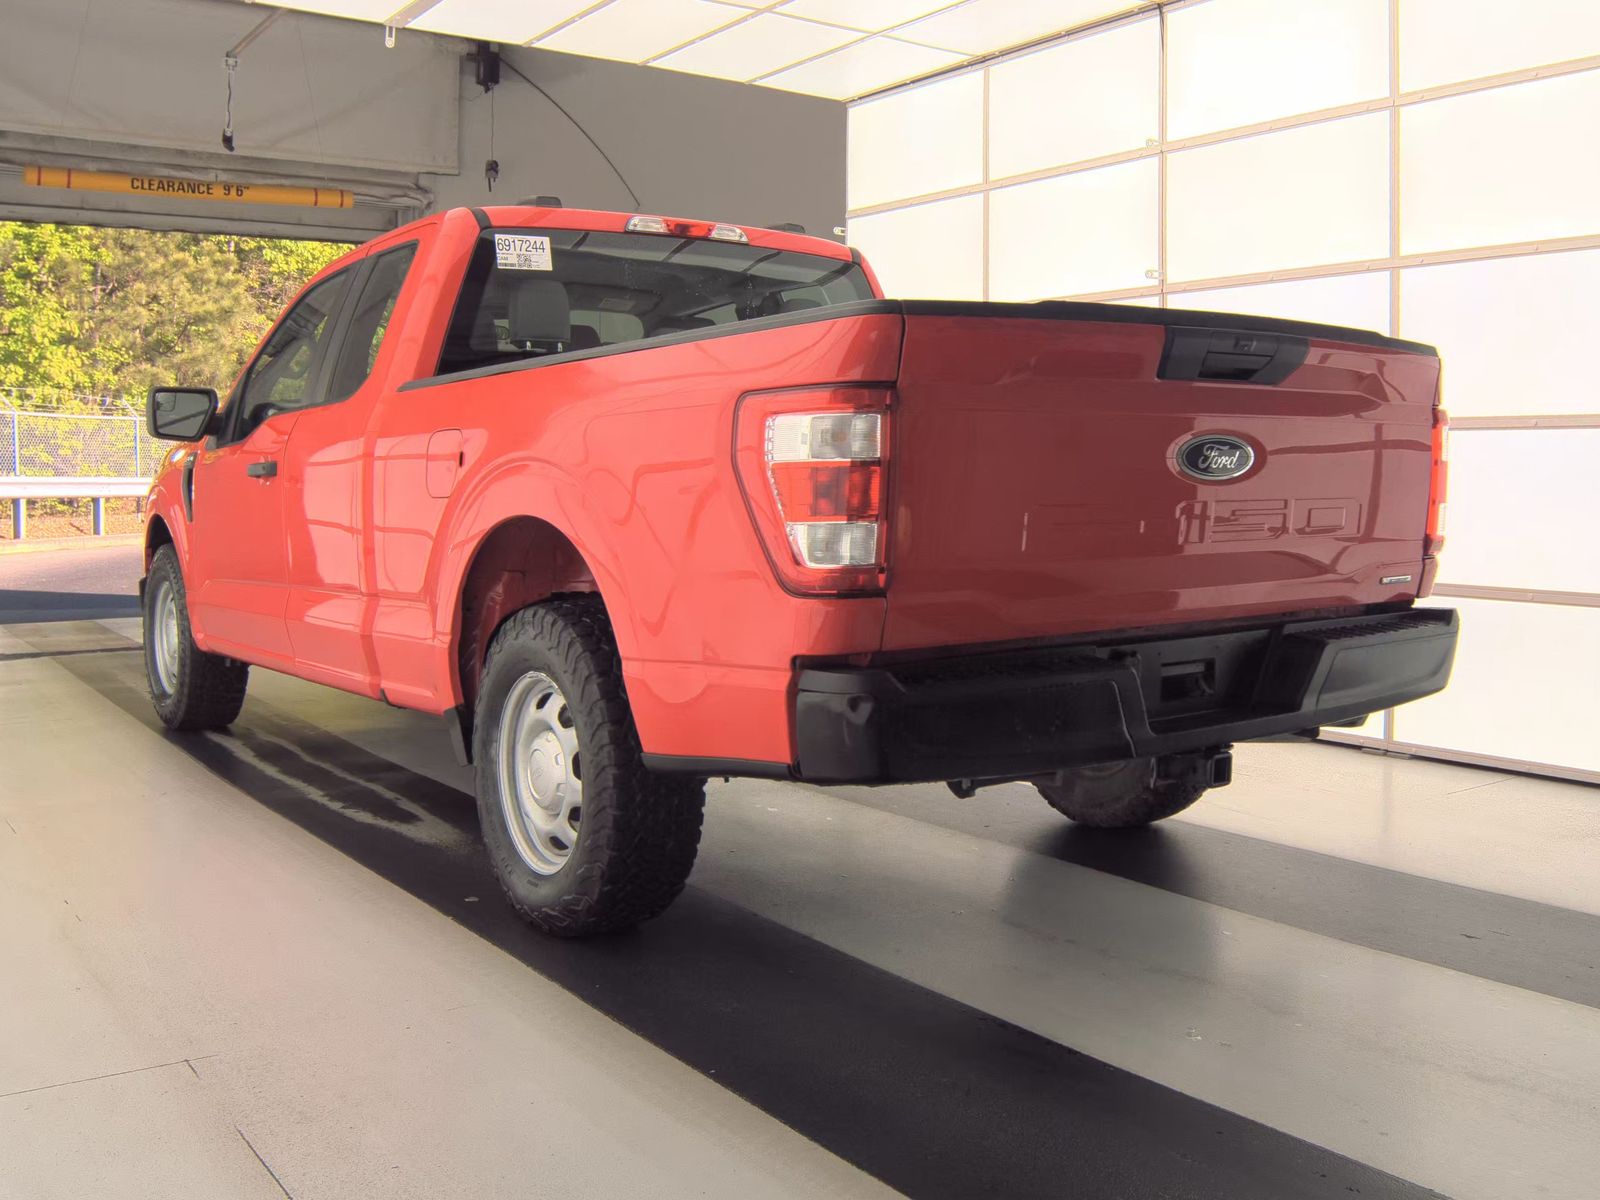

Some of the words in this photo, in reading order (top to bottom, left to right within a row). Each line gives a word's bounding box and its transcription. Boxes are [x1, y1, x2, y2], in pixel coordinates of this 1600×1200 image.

[130, 177, 214, 195] CLEARANCE
[497, 238, 545, 253] 6917244
[1200, 443, 1240, 469] Ford
